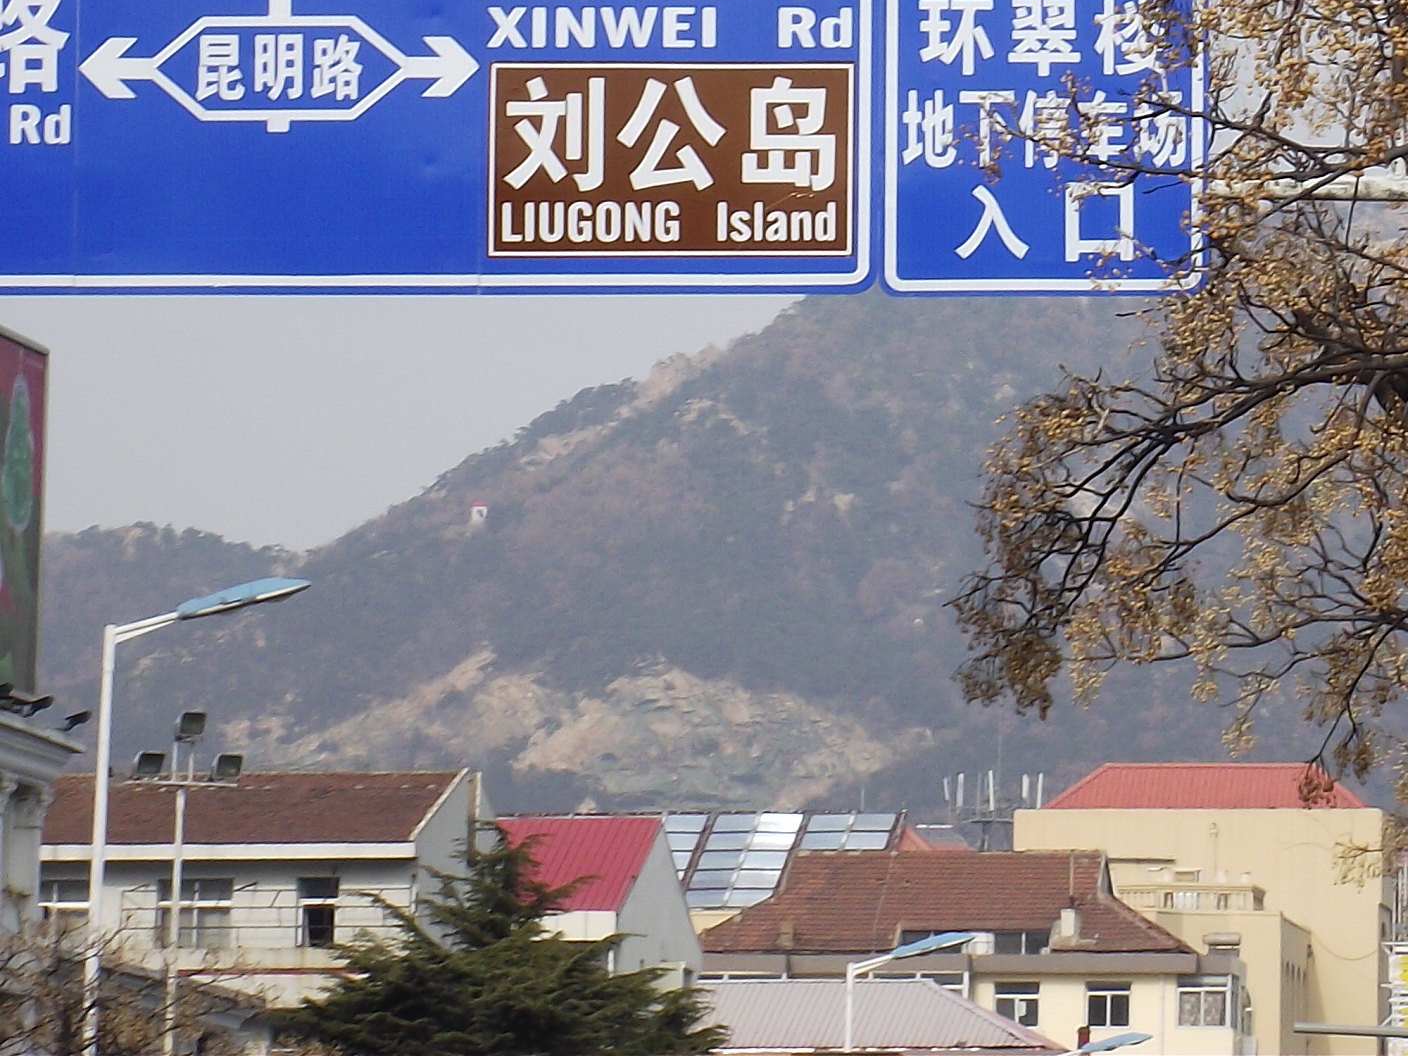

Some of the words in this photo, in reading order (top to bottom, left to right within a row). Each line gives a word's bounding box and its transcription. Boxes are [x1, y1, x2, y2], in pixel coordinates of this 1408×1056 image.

[487, 6, 717, 48] XINWEI
[778, 6, 853, 49] Rd
[196, 33, 364, 102] 昆明路
[9, 104, 72, 145] Rd
[502, 76, 838, 193] 刘公岛
[902, 89, 1187, 170] 地下停车场
[501, 201, 681, 244] LIUGONG
[717, 201, 838, 244] Island
[954, 183, 1136, 263] 入口
